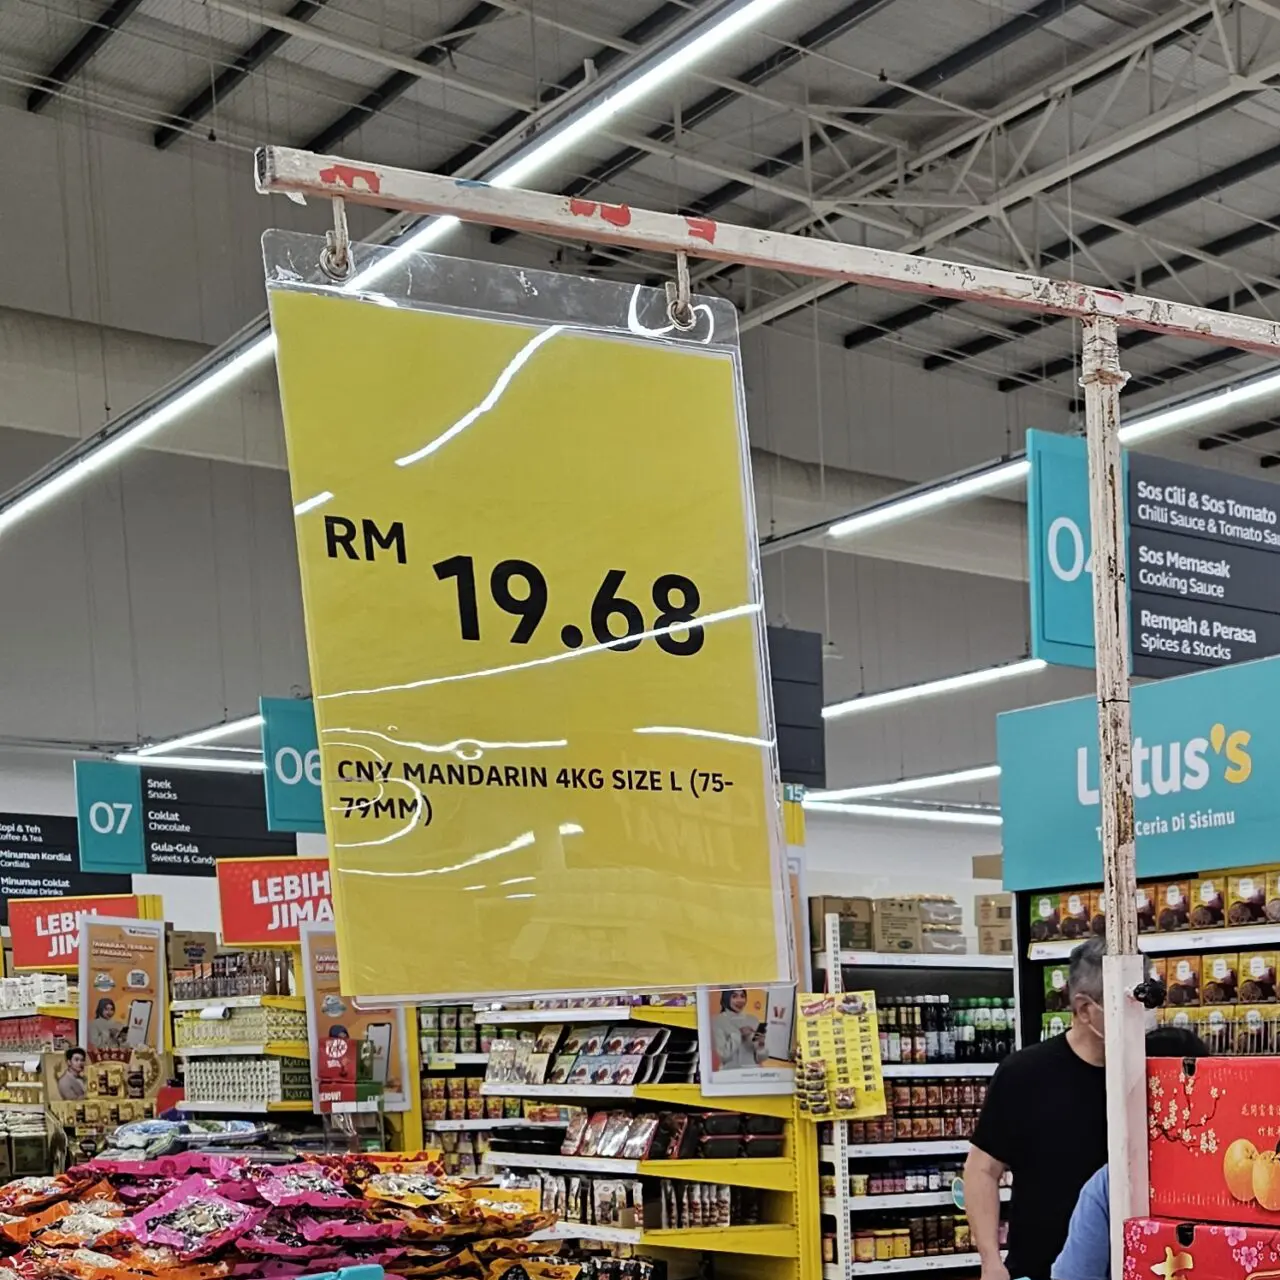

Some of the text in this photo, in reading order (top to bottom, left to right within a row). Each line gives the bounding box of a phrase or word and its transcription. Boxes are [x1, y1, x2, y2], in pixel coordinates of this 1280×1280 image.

[1138, 482, 1276, 526] Sos Cili & Sos Tomato
[1138, 504, 1168, 525] Chilli
[1170, 511, 1205, 532] Sauce
[1207, 518, 1217, 534] &
[1218, 520, 1262, 543] Tomato
[1139, 546, 1231, 580] Sos Memasak
[324, 515, 706, 657] RM 19.68
[1139, 569, 1224, 598] Cooking Sauce
[1141, 610, 1257, 644] Rempah & Perasa
[1141, 633, 1231, 661] Spices & Stocks
[1076, 723, 1252, 806] Ltus's
[147, 779, 172, 790] Snek
[337, 760, 734, 798] CNY MANDARIN 4KG SIZE L (75-
[147, 790, 178, 800] Snacks
[89, 801, 133, 834] 07
[148, 811, 180, 822] Coklat
[340, 796, 433, 826] 79MM)
[1172, 813, 1186, 832] Di
[1189, 809, 1235, 829] Sisimu
[16, 825, 23, 833] &
[25, 824, 41, 834] Teh
[30, 834, 43, 843] Tea
[148, 822, 191, 832] Chocolate
[41, 851, 72, 862] Kordial
[151, 842, 199, 853] Gula-Gula
[151, 853, 216, 866] Sweets & Candy
[1, 877, 70, 888] Minuman Coklat
[1, 886, 64, 896] Chocolate Drinks
[252, 871, 330, 904] LEBIH
[268, 898, 335, 930] JIMA
